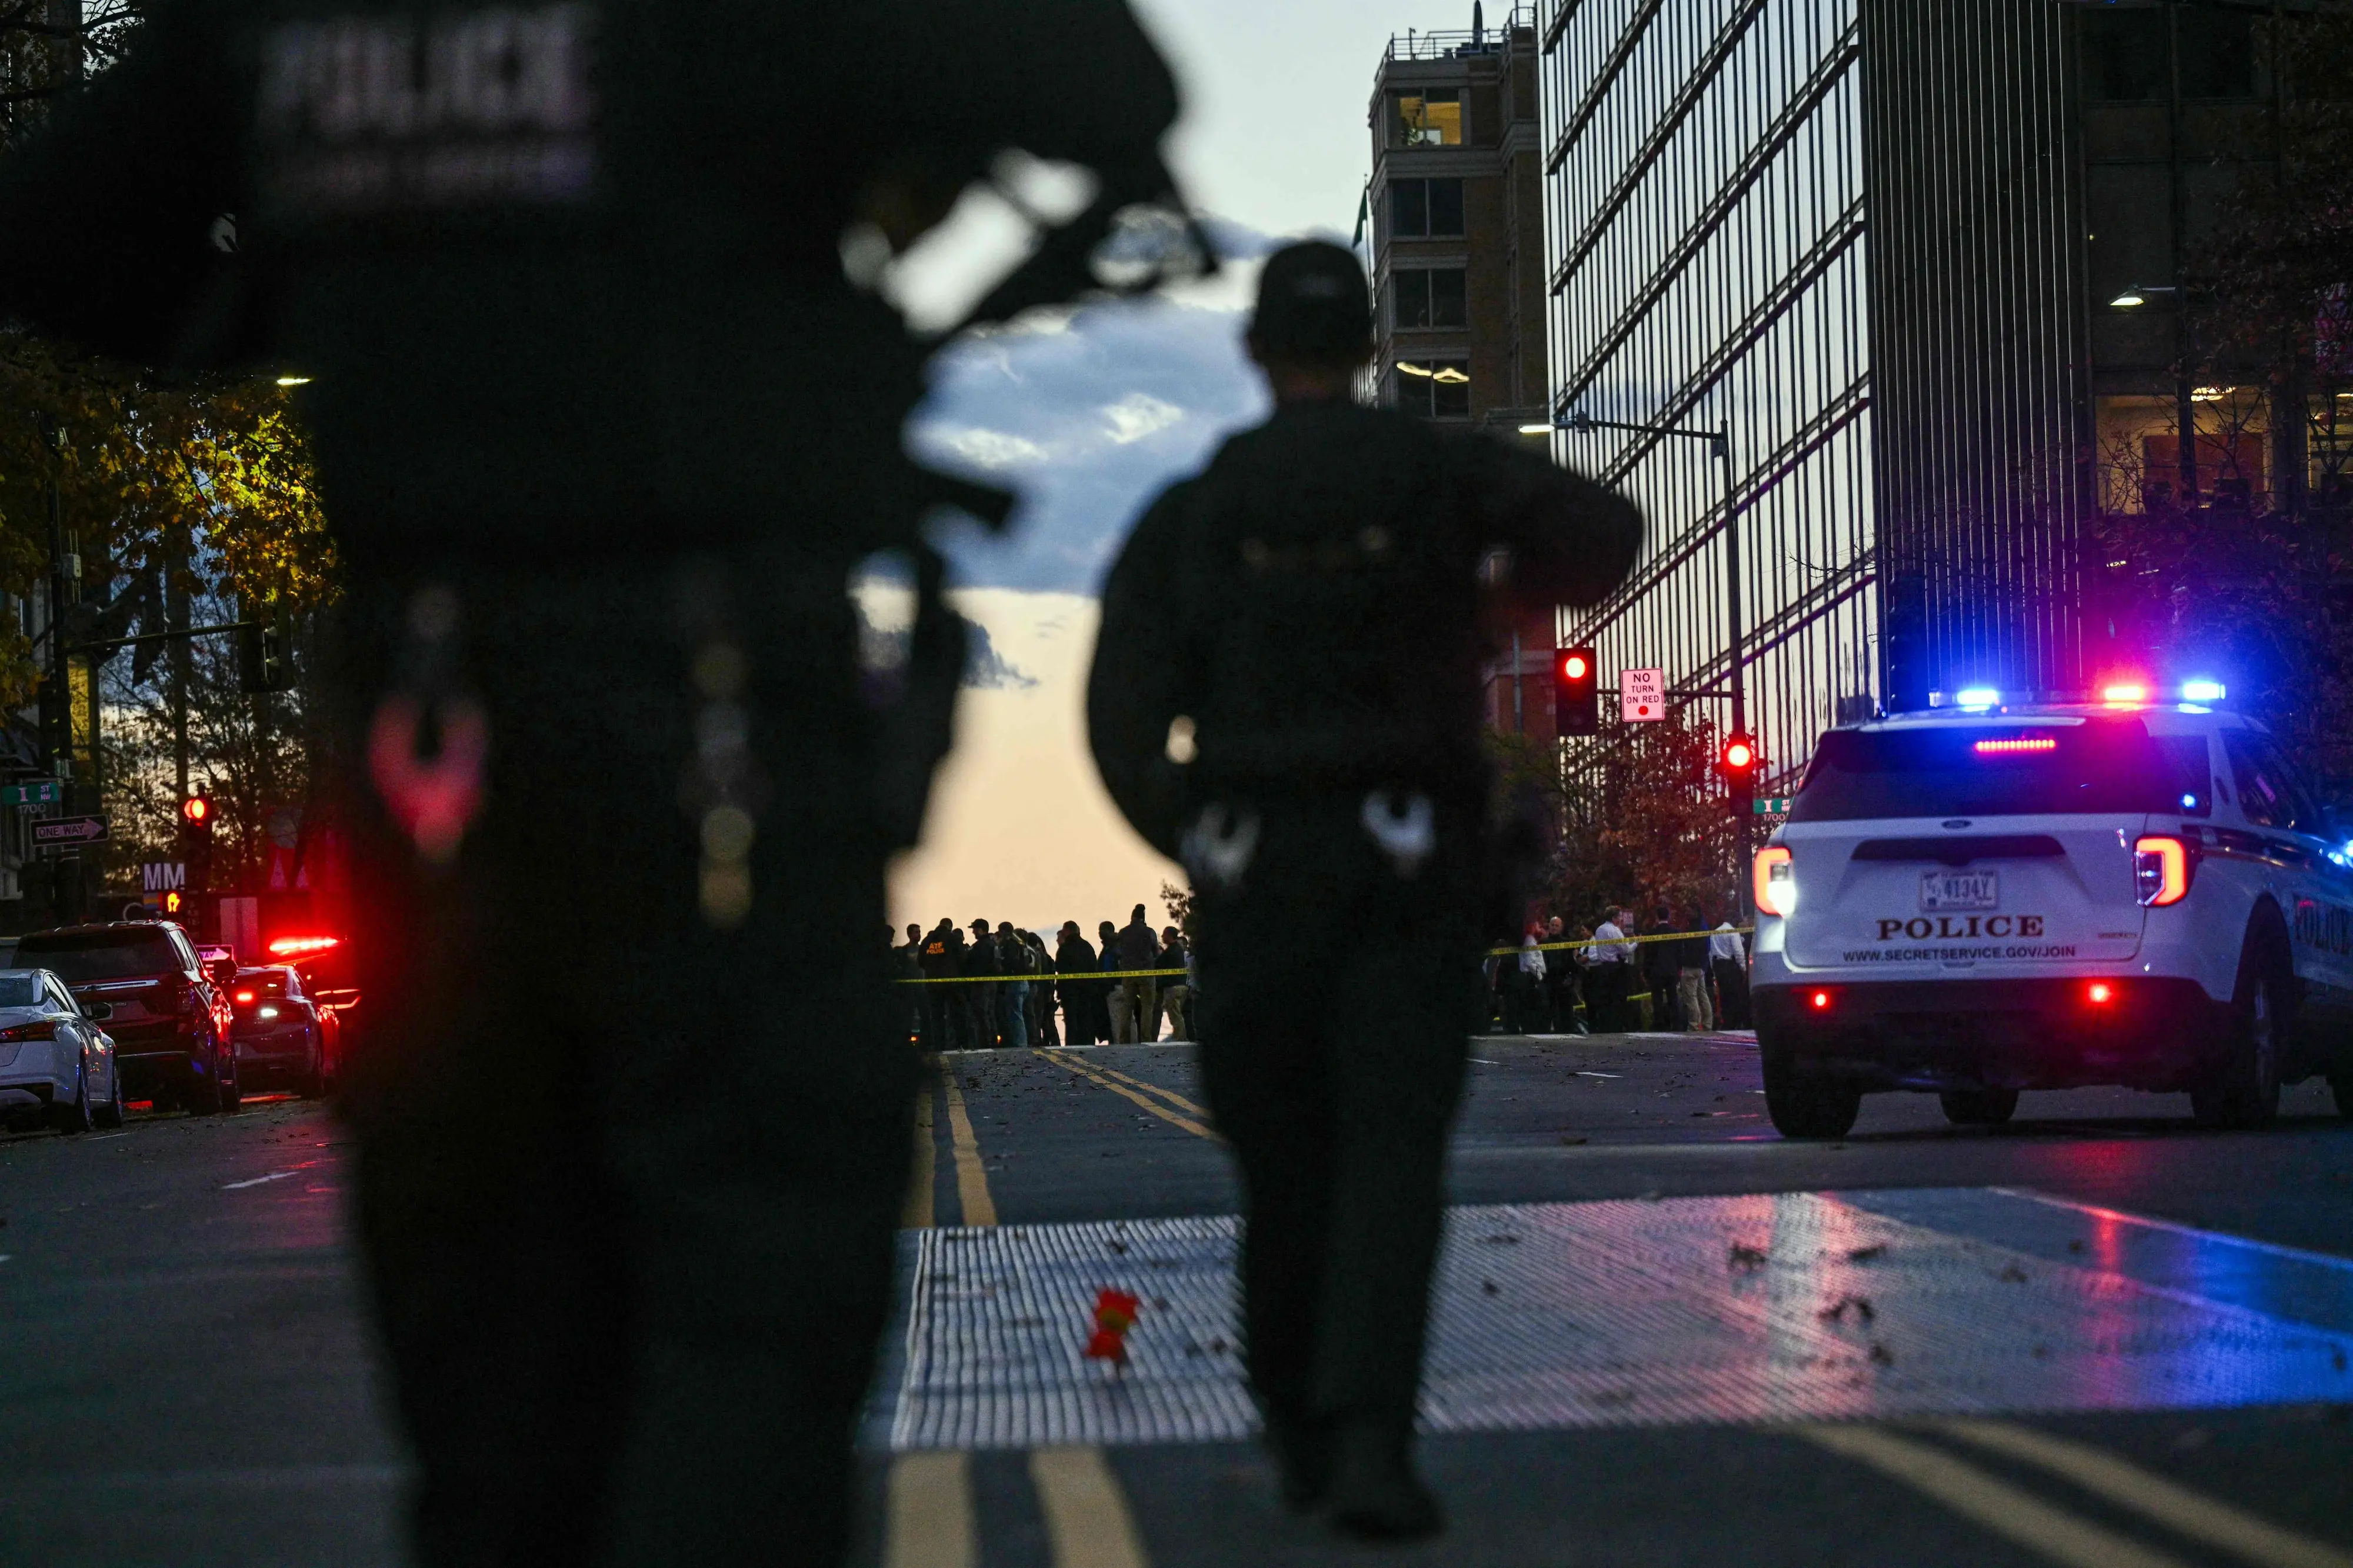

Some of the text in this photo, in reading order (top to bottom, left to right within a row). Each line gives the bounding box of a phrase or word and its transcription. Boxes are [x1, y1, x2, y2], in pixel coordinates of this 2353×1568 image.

[1634, 673, 1650, 683] NO
[1631, 685, 1654, 693] TURN
[18, 787, 28, 801] I
[18, 803, 46, 815] 1700
[1764, 800, 1772, 812] I
[39, 825, 84, 837] ONE WAY
[1876, 915, 2044, 940] POLICE
[1843, 946, 2075, 962] WWW.SECRETSERVICE.GOV/JOIN
